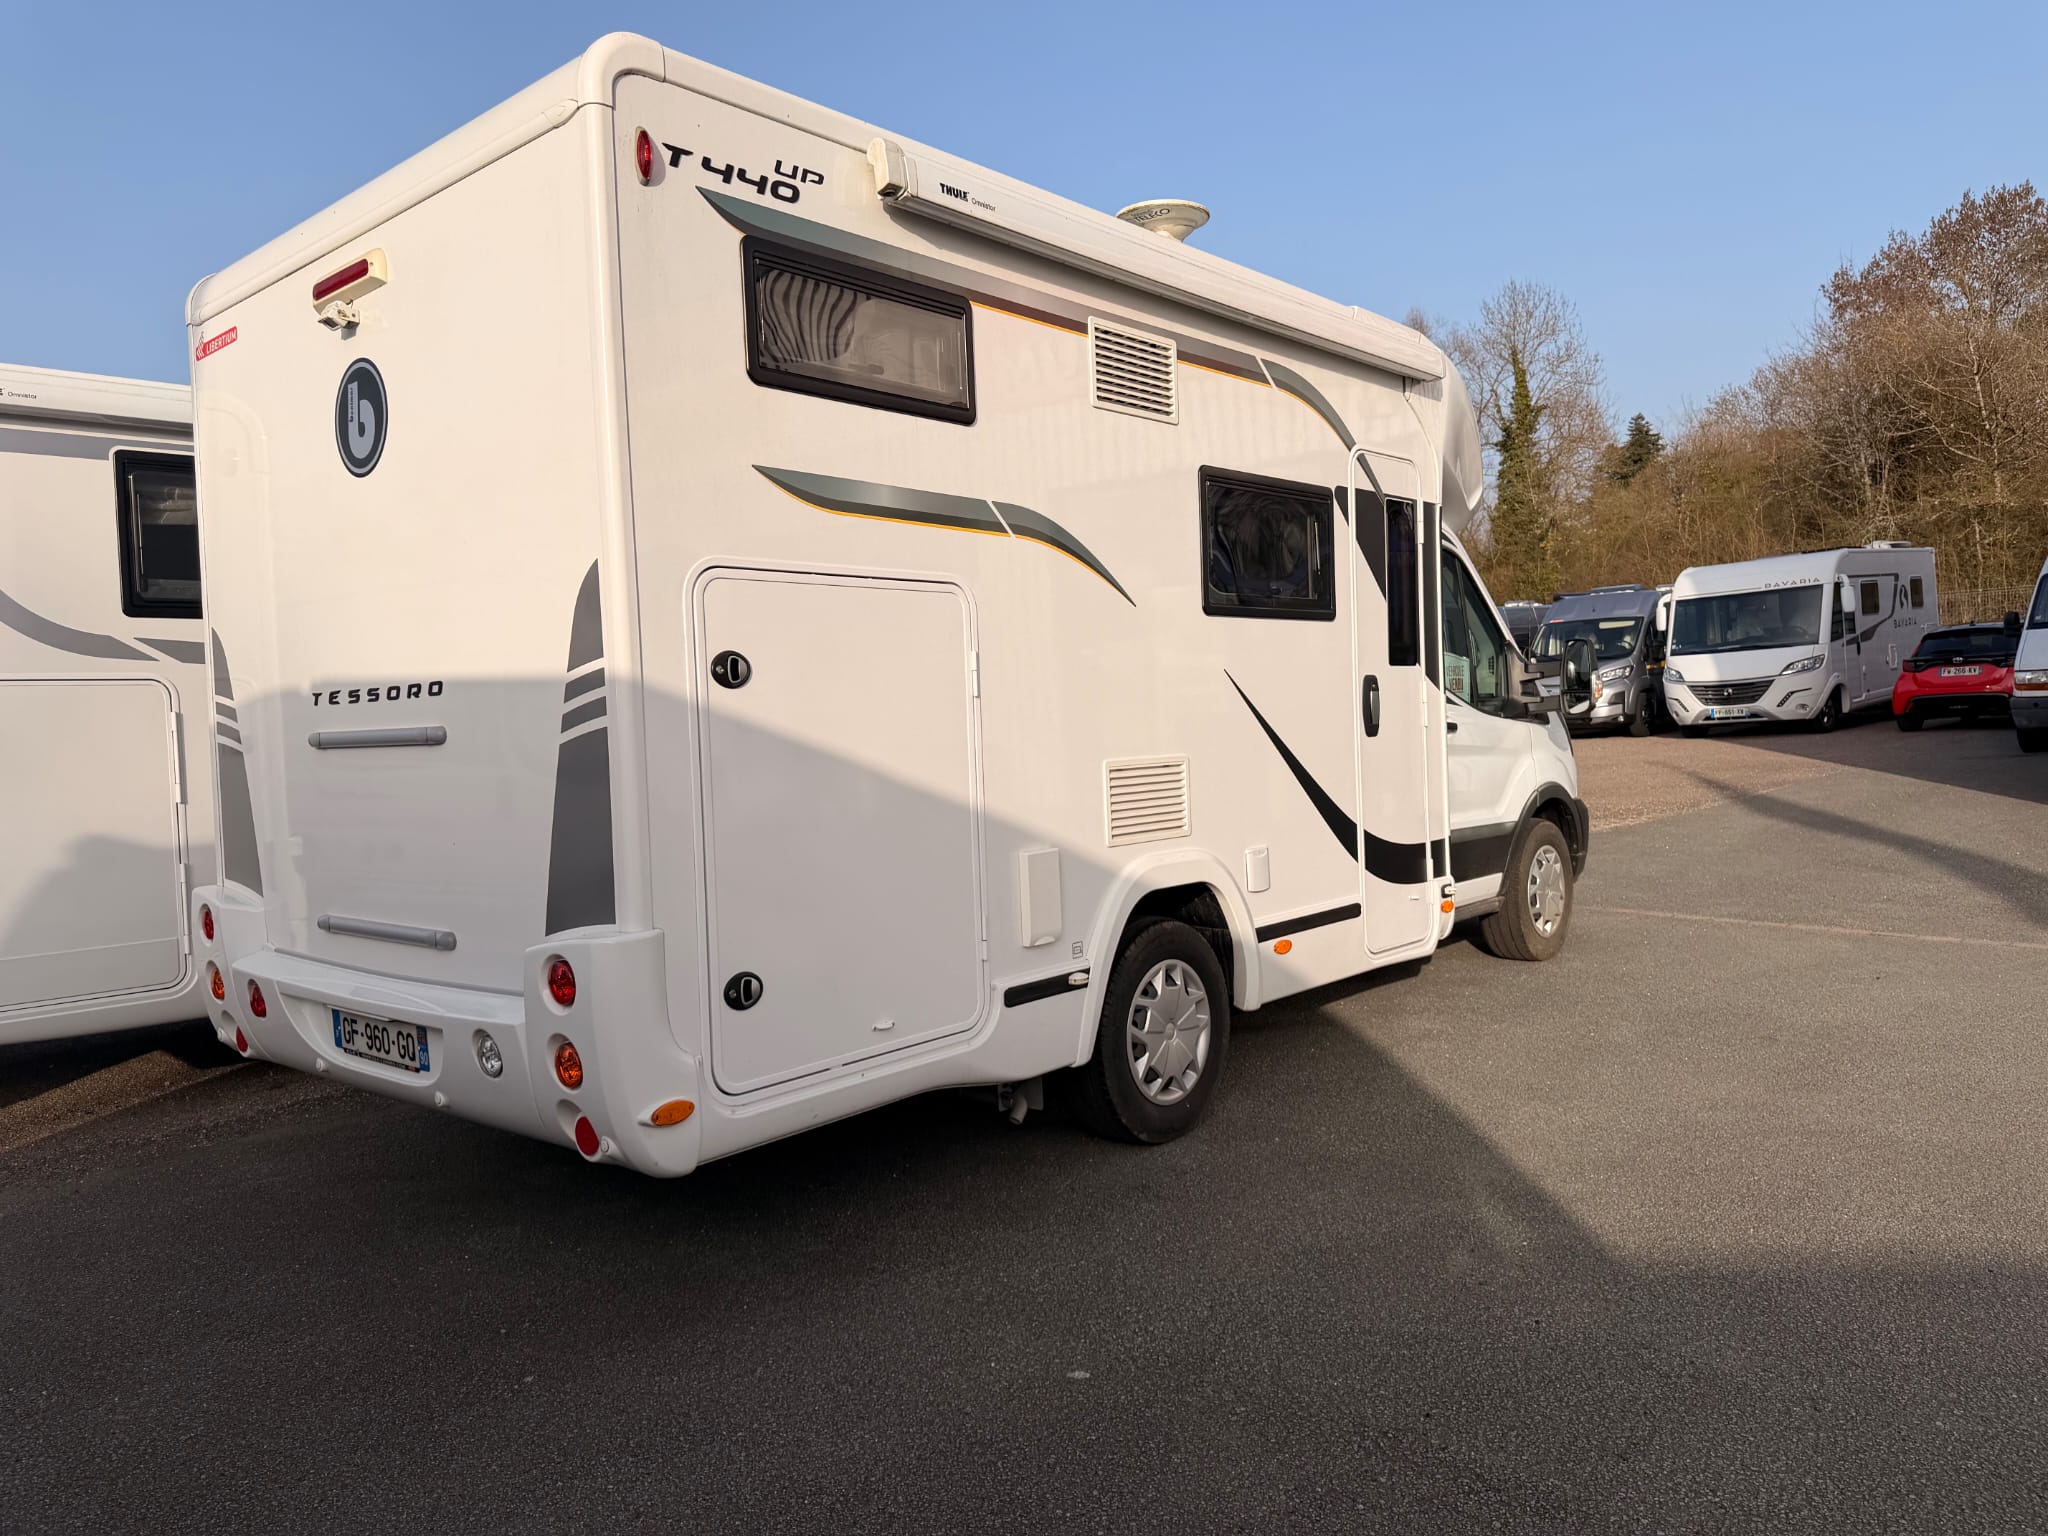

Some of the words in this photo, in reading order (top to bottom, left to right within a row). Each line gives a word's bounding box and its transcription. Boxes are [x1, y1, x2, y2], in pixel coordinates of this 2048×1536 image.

[775, 159, 825, 186] UP
[939, 182, 968, 203] THULE
[205, 331, 237, 355] LIBERTIUM
[1764, 576, 1821, 589] BAVARIA
[1893, 615, 1917, 629] BAVARIA
[311, 680, 444, 707] TESSORO
[342, 1016, 417, 1062] GF-960-GQ
